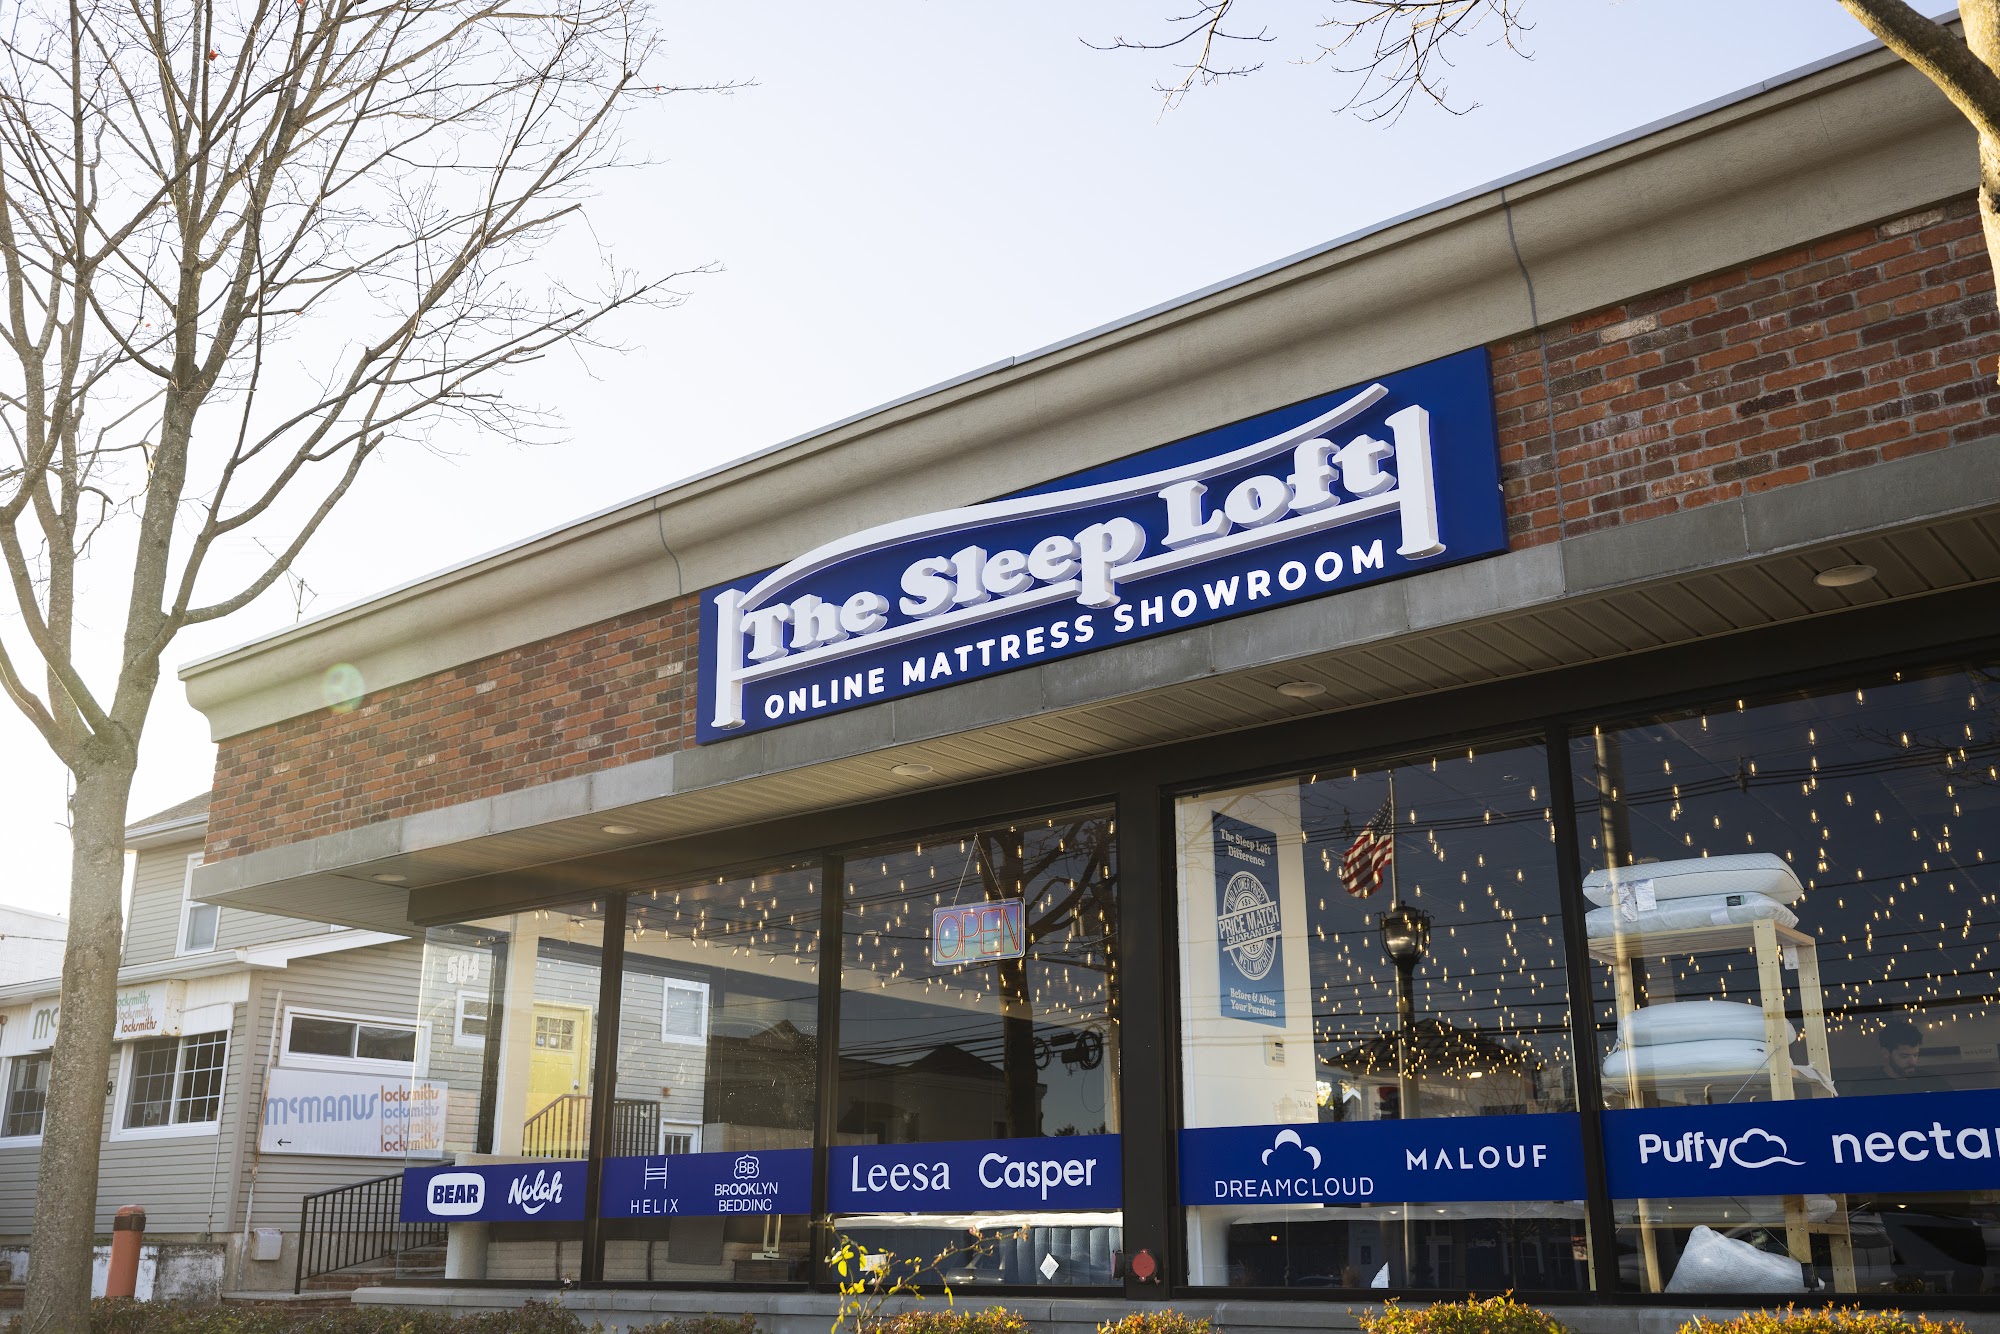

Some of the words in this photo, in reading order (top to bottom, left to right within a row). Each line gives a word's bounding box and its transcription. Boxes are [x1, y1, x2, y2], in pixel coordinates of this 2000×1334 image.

[740, 590, 889, 663] The
[900, 517, 1146, 619] Sleep
[1158, 434, 1397, 550] Loft
[764, 667, 885, 719] ONLINE
[903, 615, 1094, 686] MATTRESS
[1114, 540, 1384, 633] SHOWROOM
[1220, 829, 1234, 842] The
[1235, 834, 1255, 851] Sleep
[1256, 841, 1271, 855] Loft
[1228, 845, 1265, 867] Difference
[938, 905, 1019, 959] OPEN
[1219, 915, 1246, 939] PRICE
[1246, 905, 1279, 931] MATCH
[1227, 924, 1275, 945] GUARANTEE
[447, 953, 480, 984] 504
[1230, 988, 1251, 1002] Before
[1252, 993, 1258, 1002] &
[1259, 994, 1276, 1007] After
[1231, 1000, 1246, 1012] Your
[1248, 1003, 1276, 1017] Purchase
[121, 1016, 157, 1033] locksmiths
[381, 1083, 439, 1103] locksmiths
[381, 1100, 439, 1120] locksmiths
[381, 1118, 439, 1136] locksmiths
[381, 1135, 439, 1153] locksmiths
[1639, 1131, 1728, 1169] Puffy
[739, 1161, 756, 1175] BB
[1406, 1144, 1547, 1171] MALOUF
[851, 1155, 951, 1193] Leesa
[978, 1152, 1097, 1200] Casper
[433, 1184, 479, 1204] BEAR
[507, 1169, 563, 1206] Nolah
[714, 1182, 779, 1196] BROOKLYN
[1215, 1177, 1374, 1198] DREAMCLOUD
[631, 1199, 679, 1214] HELIX
[718, 1198, 772, 1212] BEDDING
